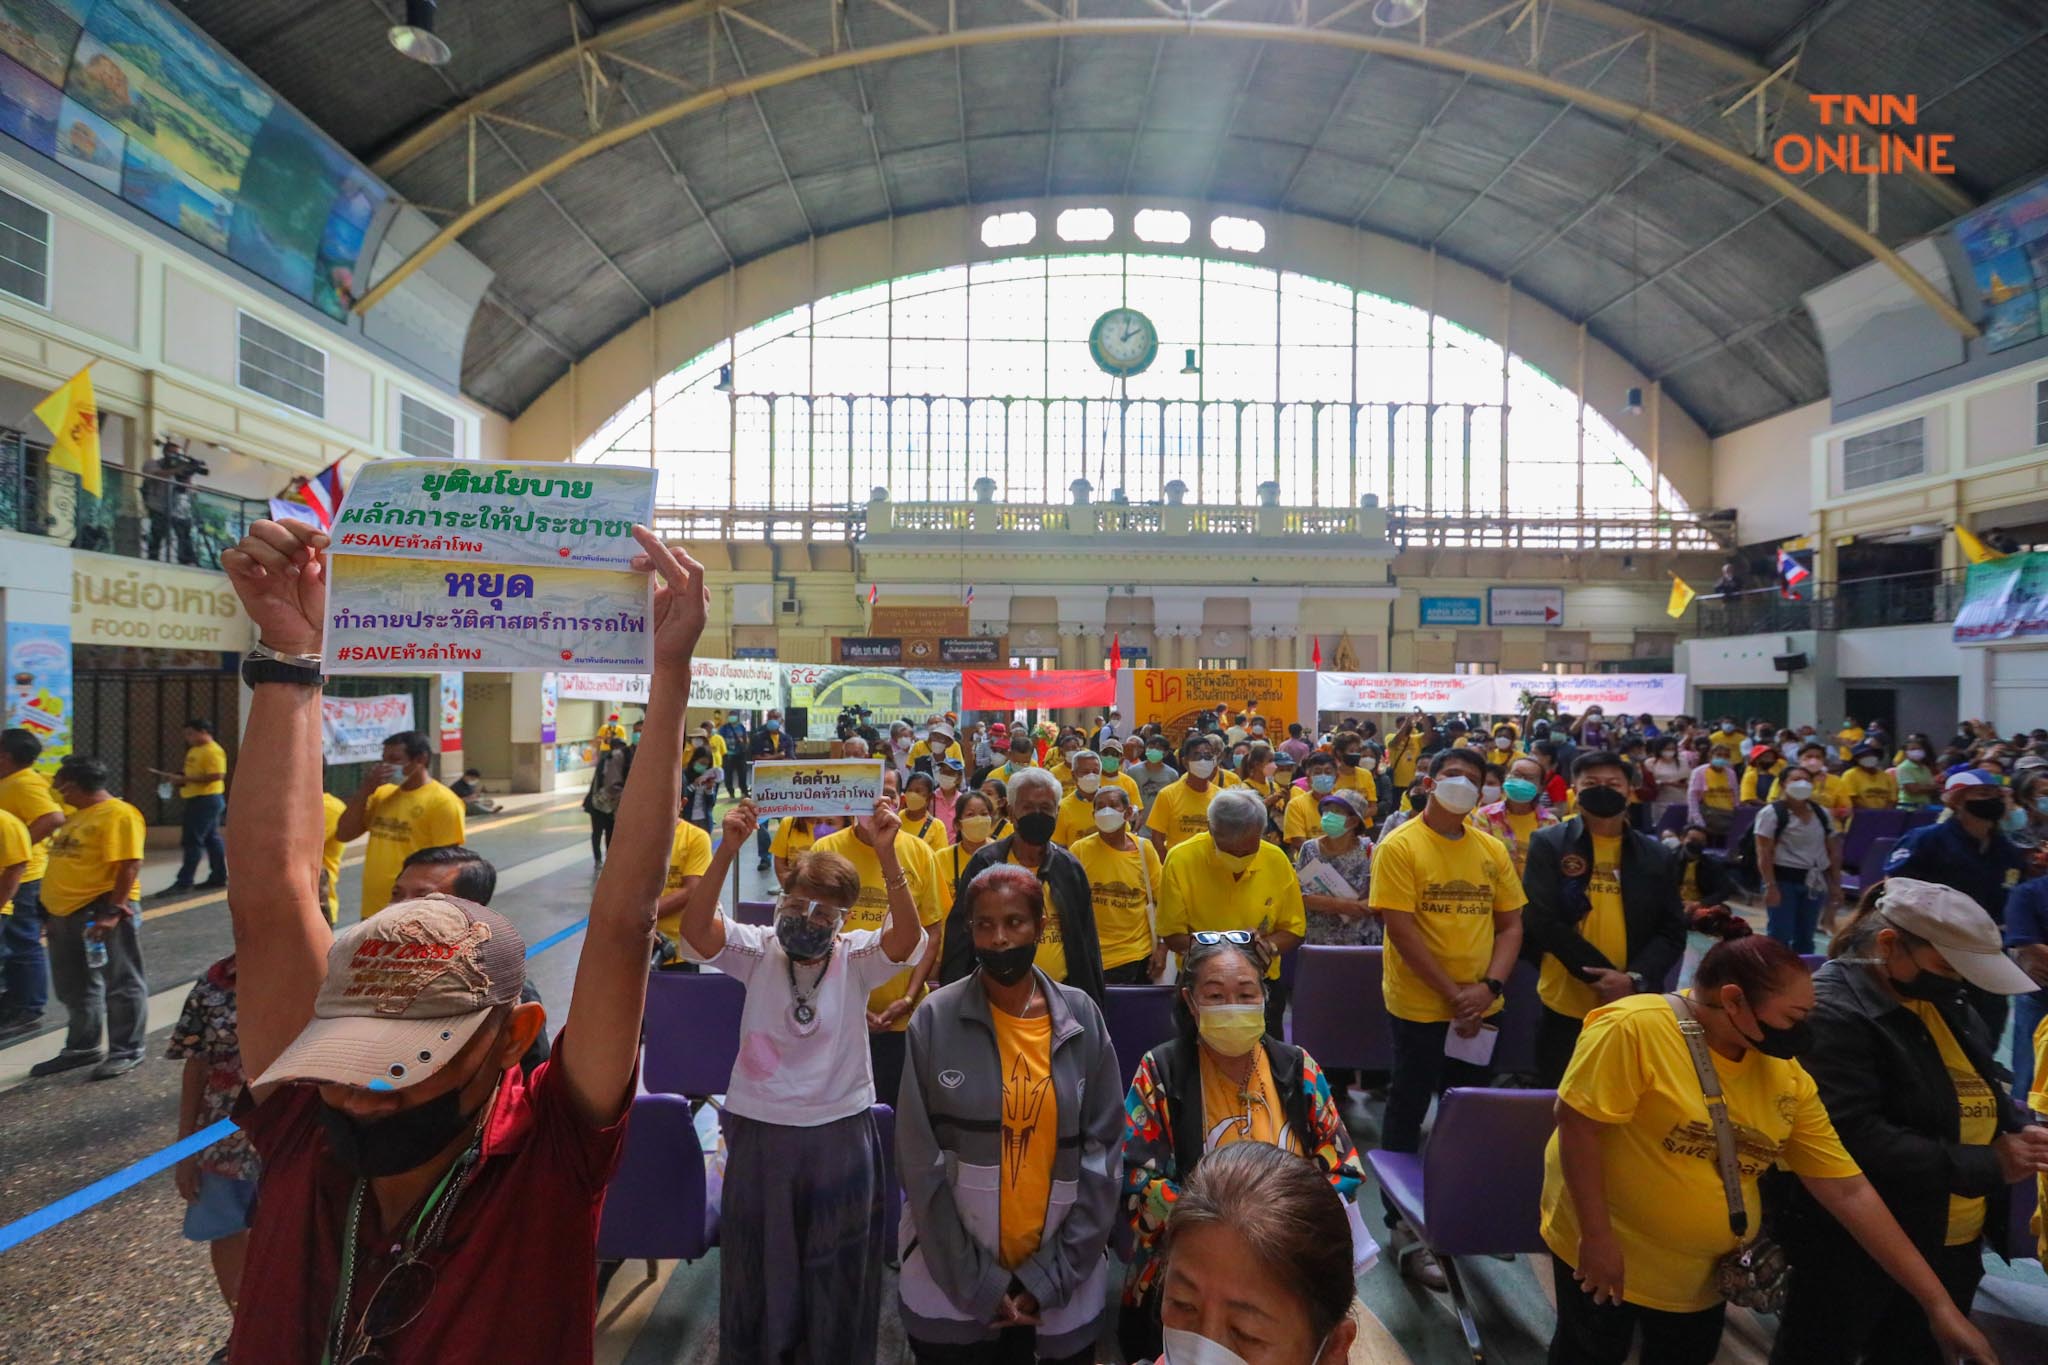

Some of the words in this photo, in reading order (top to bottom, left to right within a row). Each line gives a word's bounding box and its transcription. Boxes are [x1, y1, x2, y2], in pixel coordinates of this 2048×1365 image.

[421, 468, 594, 501] ยุตินโยบาย
[341, 533, 483, 552] #SAVEหัวลำโพง
[445, 571, 535, 611] หยุด
[91, 618, 149, 638] FOOD
[158, 624, 221, 641] COURT
[333, 609, 645, 633] ทำลายประวัติศาสตร์การรถไฟ
[338, 642, 481, 661] #SAVEหัวลำโพง
[1145, 671, 1182, 702] ปิด
[792, 769, 840, 786] คัดค้าน
[756, 786, 875, 801] นโยบายปิดหัวลำโพง
[1421, 902, 1452, 914] SAVE
[1662, 1137, 1711, 1159] SAVE
